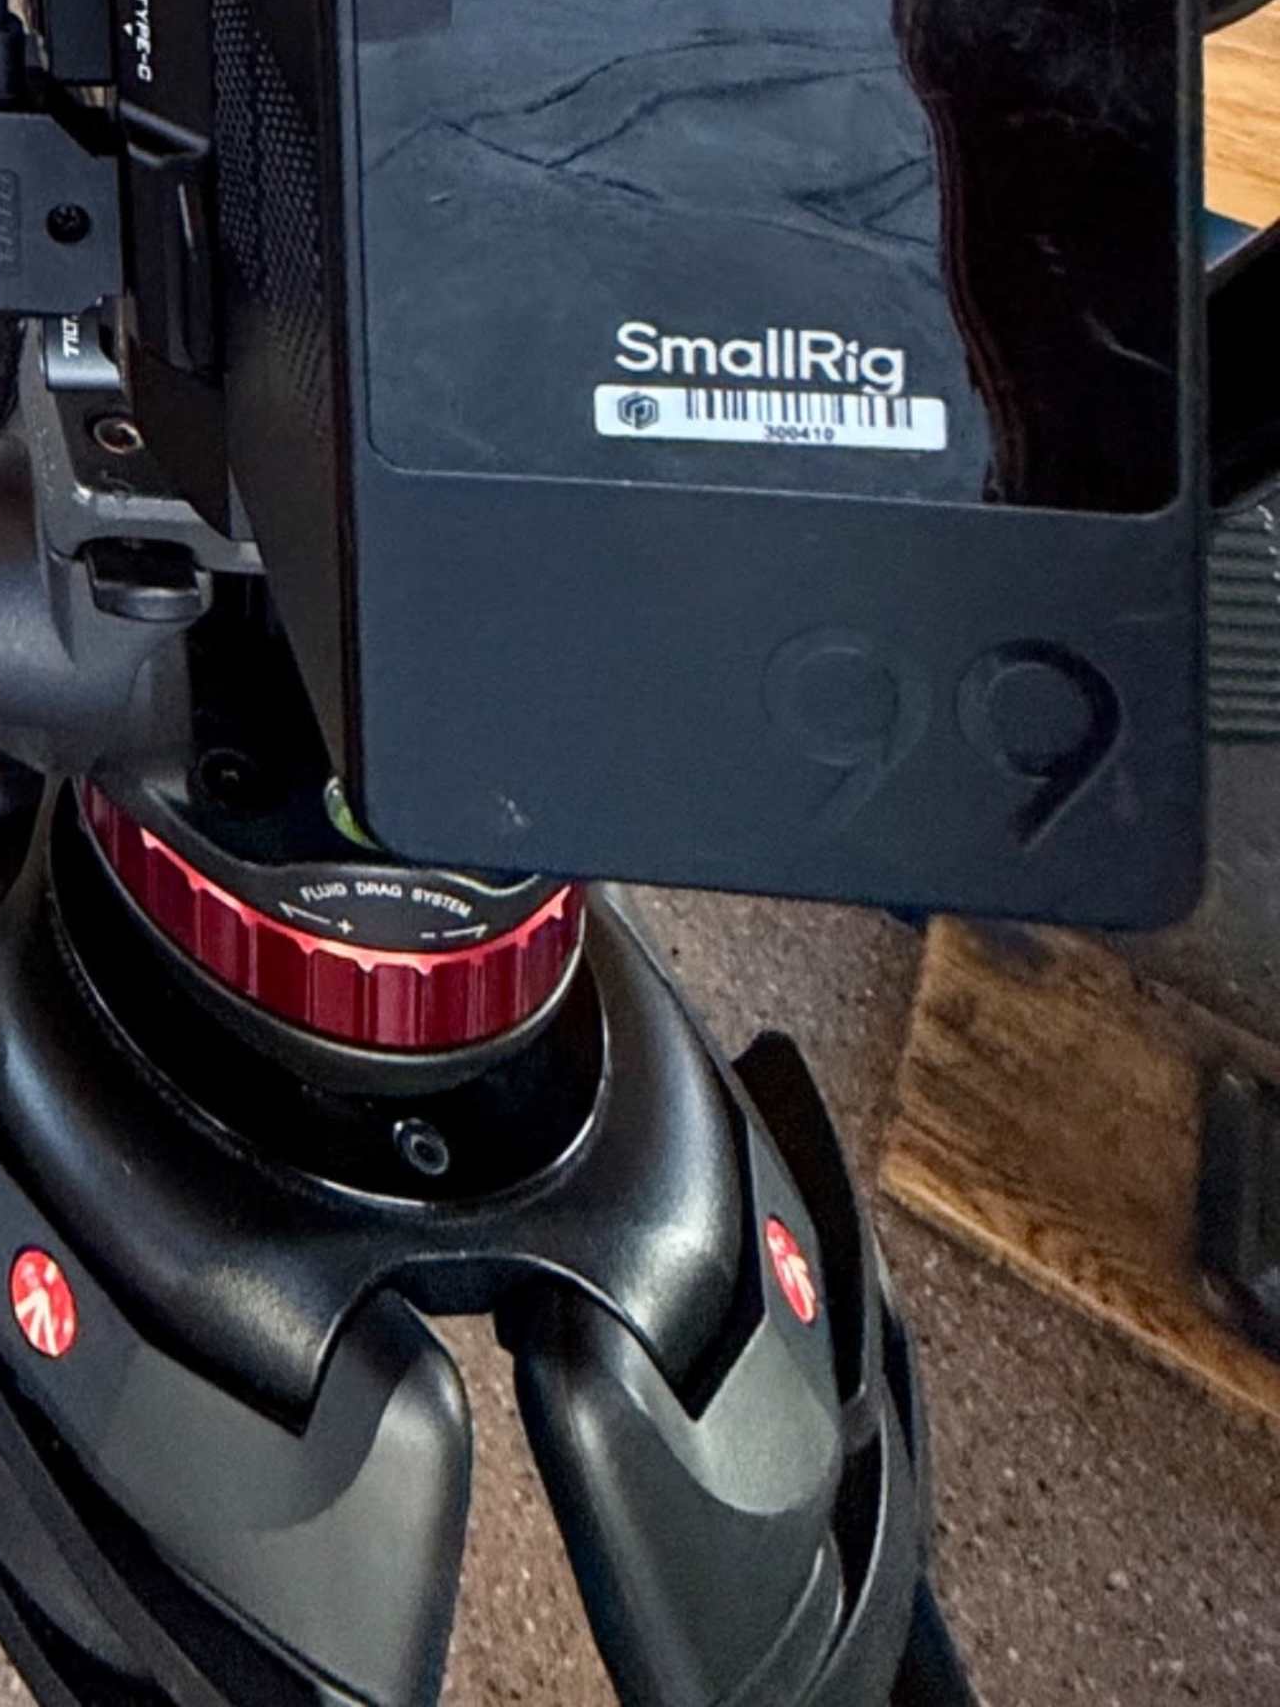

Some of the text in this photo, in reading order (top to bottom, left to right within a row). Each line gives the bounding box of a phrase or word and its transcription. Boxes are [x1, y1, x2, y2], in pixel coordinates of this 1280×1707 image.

[614, 322, 906, 395] SmallRig
[760, 624, 1125, 852] 99
[299, 880, 474, 919] FLUID DRAG SYSTEM
